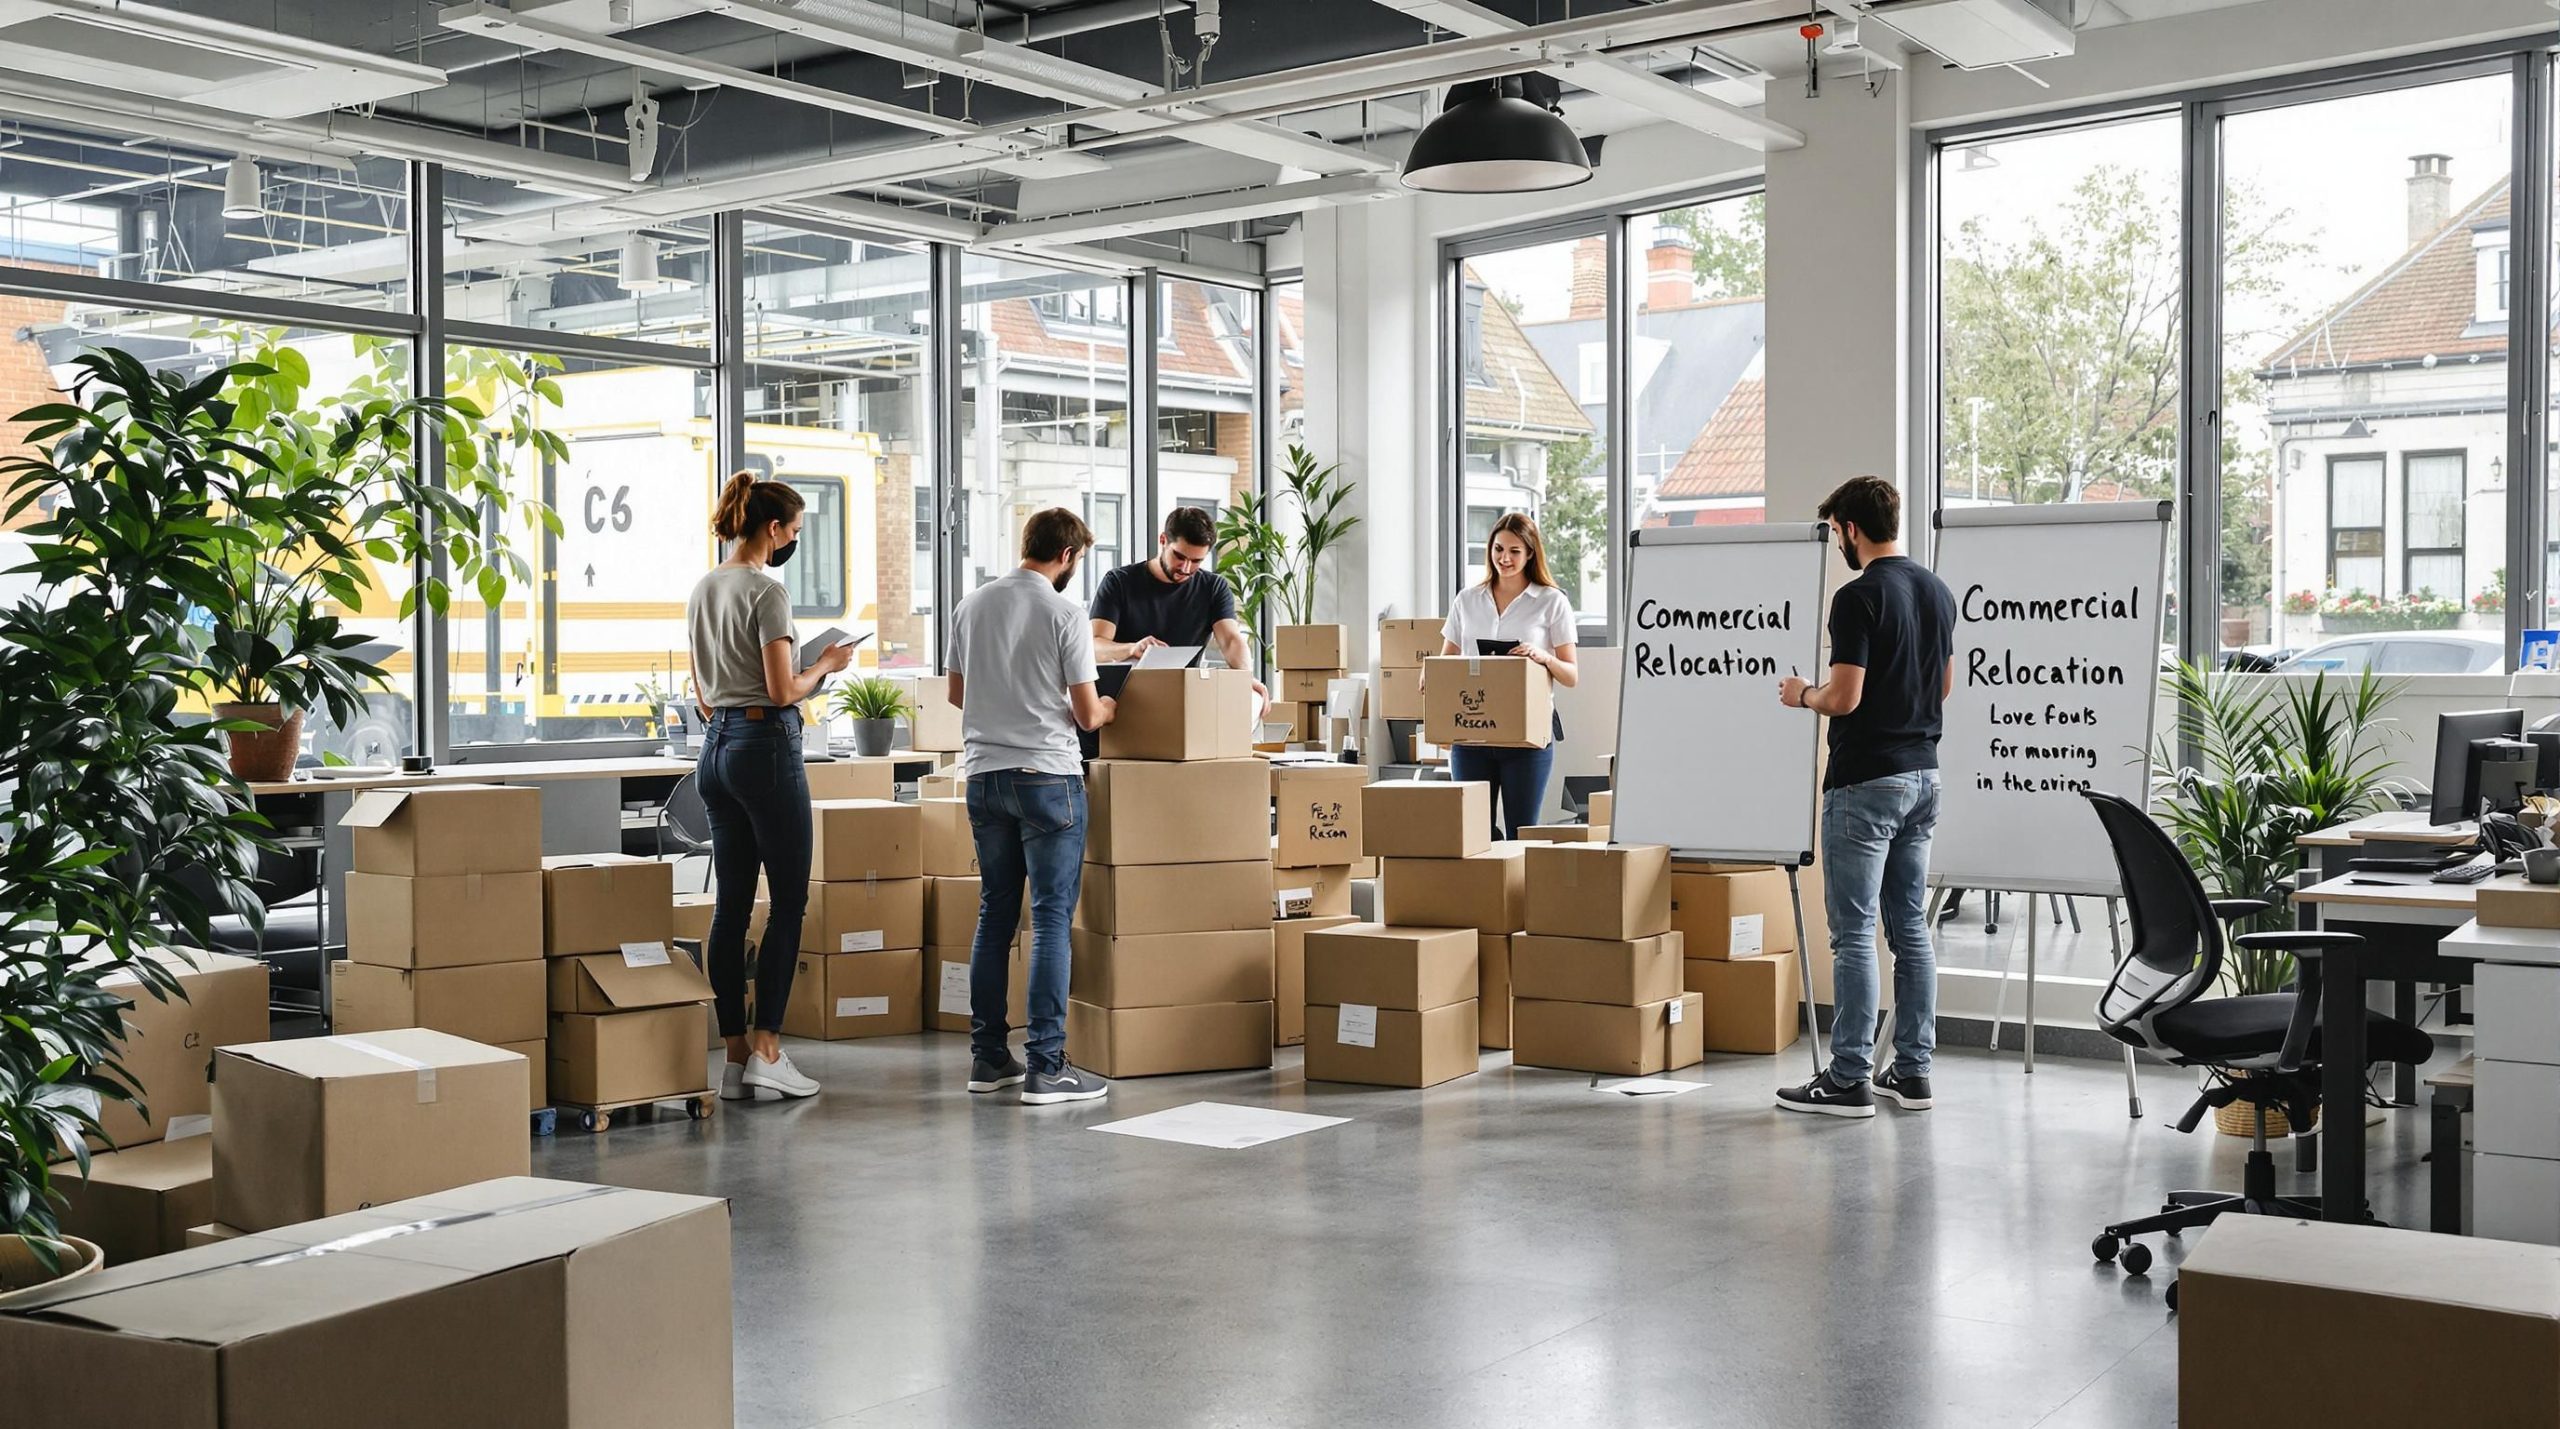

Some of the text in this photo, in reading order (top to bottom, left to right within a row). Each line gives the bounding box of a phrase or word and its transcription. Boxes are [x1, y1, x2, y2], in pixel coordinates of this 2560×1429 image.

[584, 485, 632, 533] C6
[1637, 599, 1791, 631] Commercial
[1961, 583, 2139, 623] Commercial
[1635, 642, 1776, 679] Relocation
[1967, 647, 2124, 687] Relocation
[1990, 702, 2037, 726] Love
[1990, 737, 2019, 758] for
[1976, 772, 1993, 791] in
[2002, 771, 2037, 792] the
